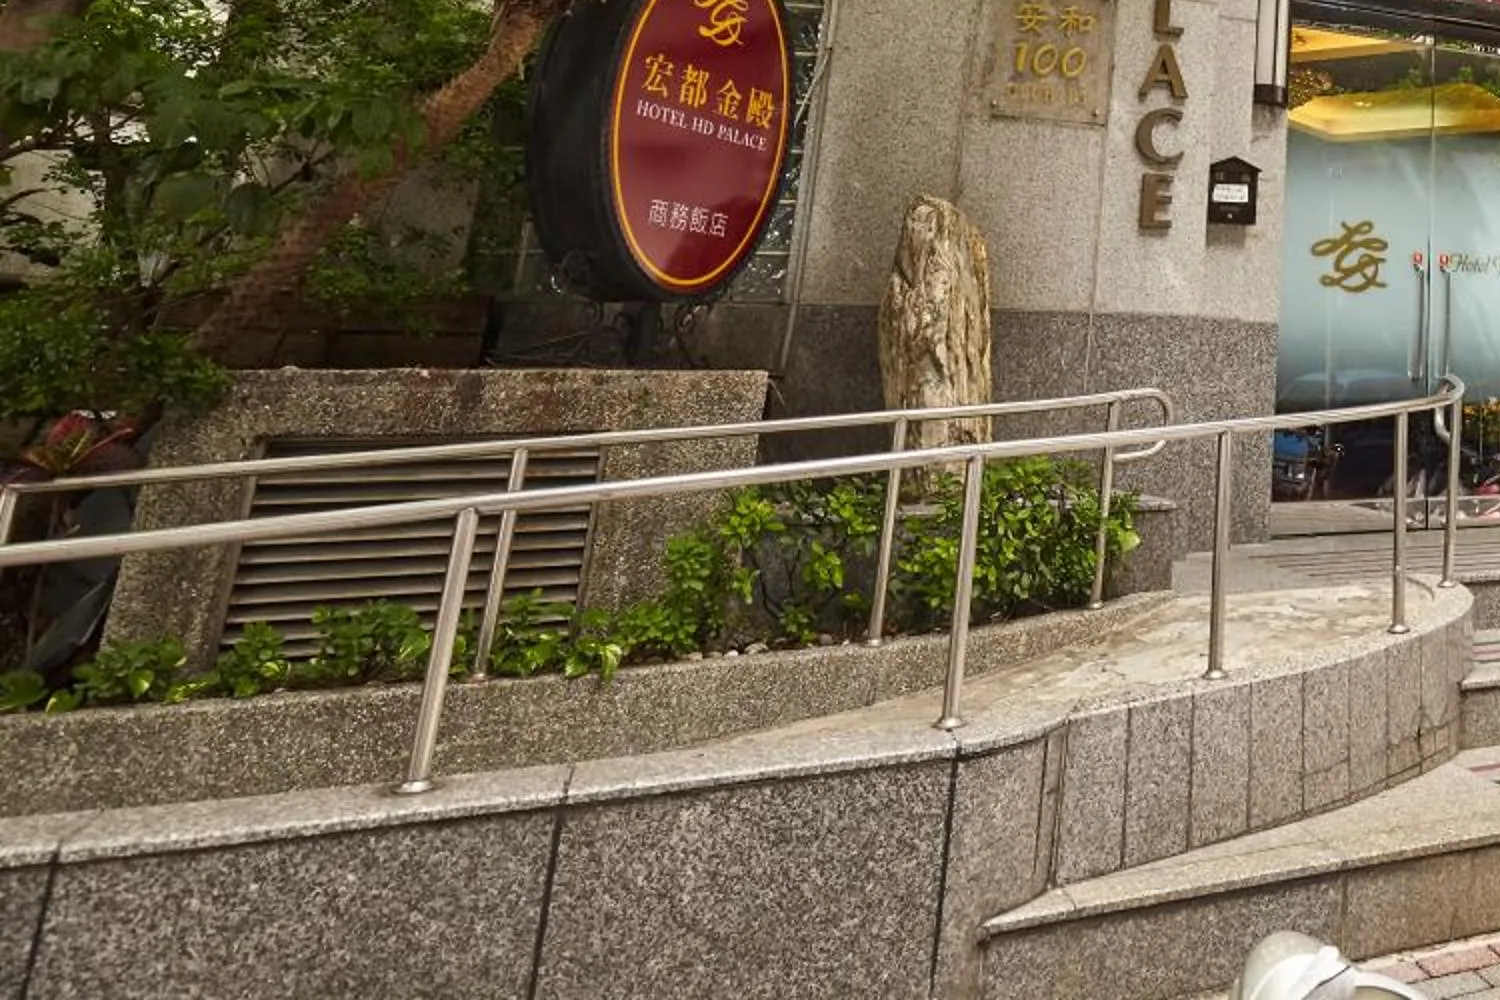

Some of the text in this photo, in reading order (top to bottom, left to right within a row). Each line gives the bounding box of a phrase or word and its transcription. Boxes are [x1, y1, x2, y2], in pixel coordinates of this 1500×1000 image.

[1014, 0, 1097, 36] 安和
[1014, 42, 1089, 78] 100
[642, 53, 778, 130] 宏都金殿
[636, 99, 769, 151] HOTEL HD PALACE
[649, 198, 729, 238] 商務飯店
